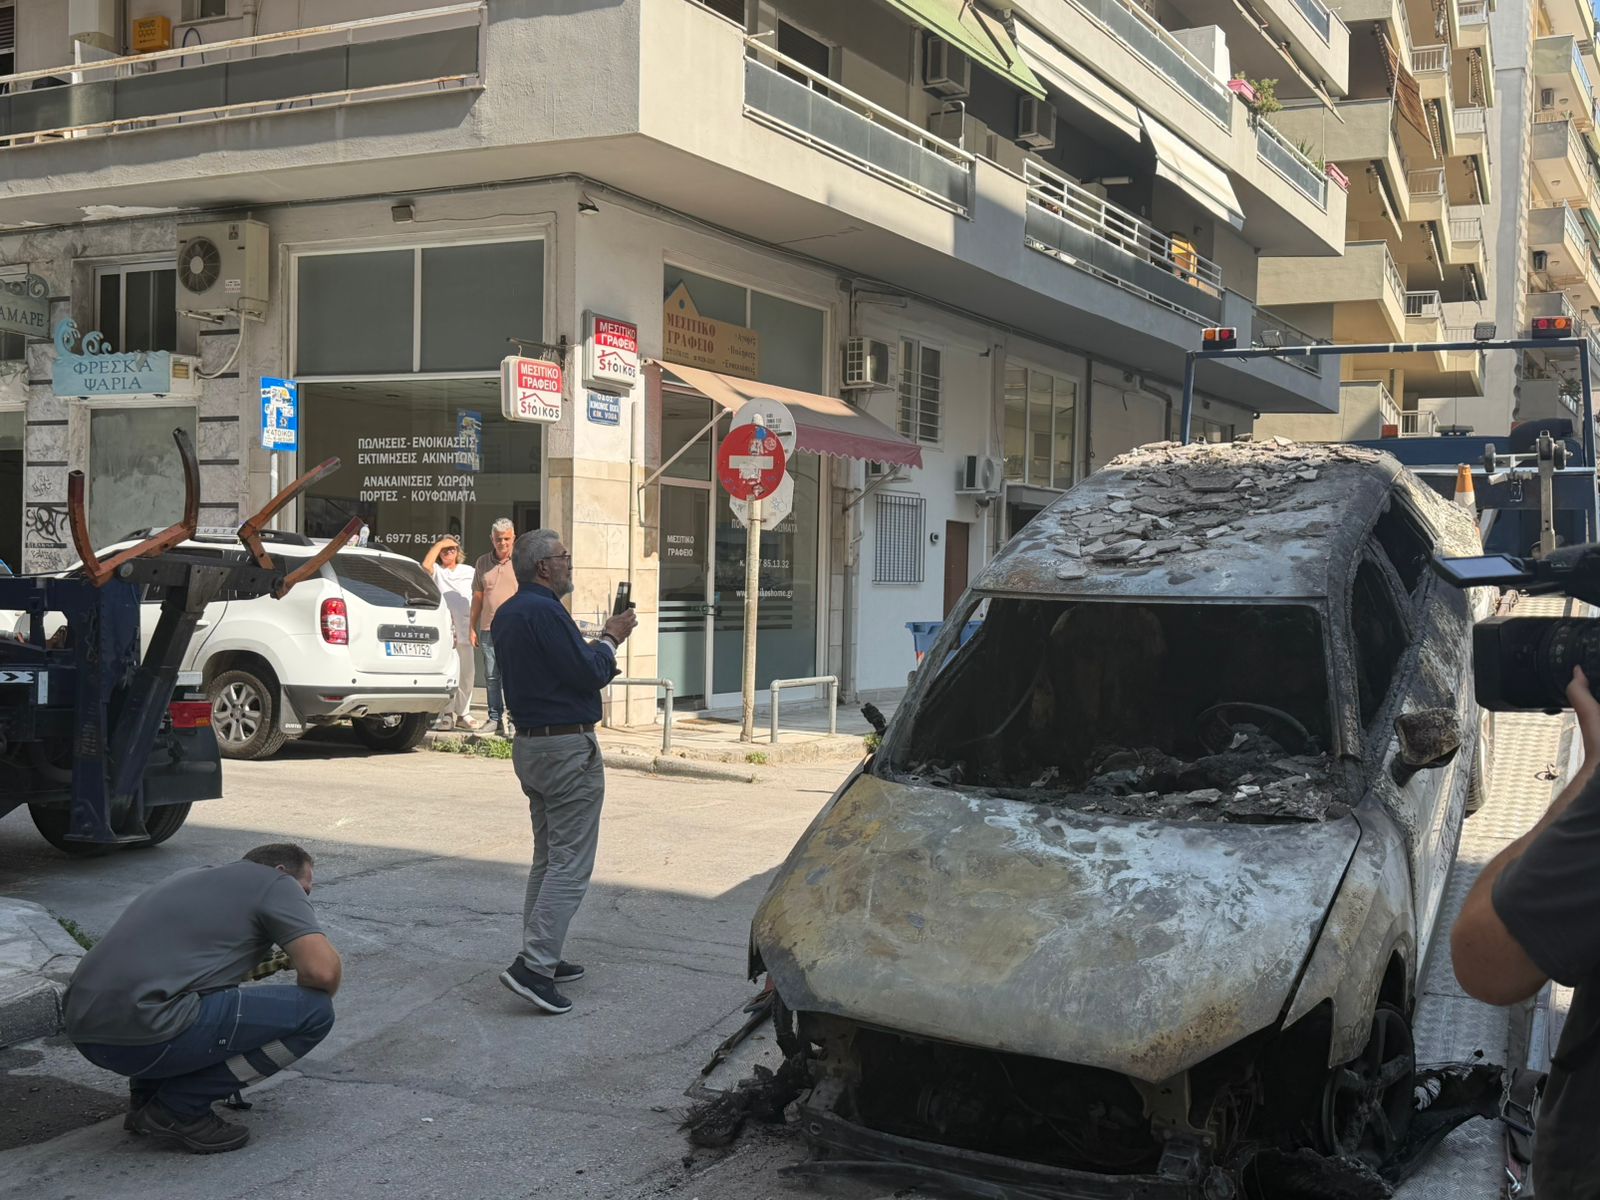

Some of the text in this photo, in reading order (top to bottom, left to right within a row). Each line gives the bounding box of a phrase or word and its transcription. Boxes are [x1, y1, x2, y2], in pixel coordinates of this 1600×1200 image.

[600, 321, 636, 339] ΜΕΣΙΤΙΚΟ
[667, 312, 716, 337] ΜΕΣΙΤΙΚΟ
[600, 334, 635, 351] ΓΡΑΦΕΙΟ
[668, 330, 714, 354] ΓΡΑΦΕΙΟ
[73, 359, 153, 375] ΦΡΕΣΚΑ
[520, 362, 559, 379] ΜΕΣΙΤΙΚΟ
[84, 376, 143, 391] ΨΑΡΙΑ
[521, 376, 558, 391] ΓΡΑΦΕΙΟ
[358, 452, 474, 464] ΕΚΤΙΜΗΣΕΙΣ ΑΚΙΝΗΤΩΝ
[363, 475, 474, 487] ΑΝΑΚΑΙΝΙΣΕΙΣ ΧΩΡΩΝ
[360, 490, 398, 502] ΠΟΡΤΕΣ
[411, 490, 476, 502] ΚΟΥΦΩΜΑΤΑ
[386, 533, 412, 543] 6977
[666, 535, 695, 544] ΜΕΣΙΤΙΚΟ
[667, 548, 693, 557] ΓΡΑΦΕΙΟ
[394, 631, 430, 639] DUSTER
